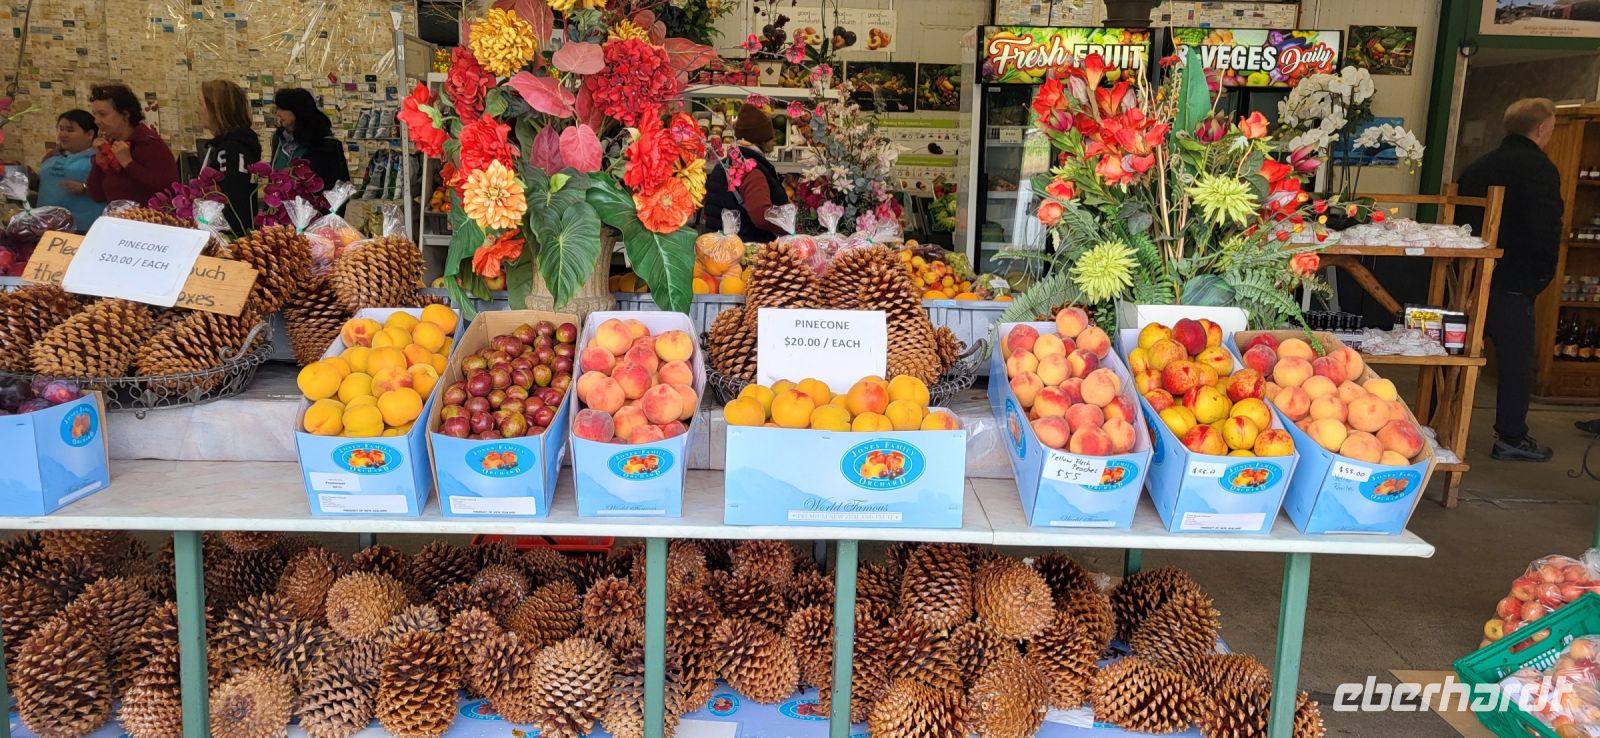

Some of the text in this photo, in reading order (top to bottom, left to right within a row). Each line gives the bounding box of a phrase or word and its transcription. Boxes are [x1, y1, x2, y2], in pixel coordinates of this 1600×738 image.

[990, 36, 1068, 75] Fresh
[1200, 45, 1277, 71] VEGES
[1281, 43, 1333, 75] Daily
[118, 239, 169, 254] PINECONE
[99, 252, 133, 265] $20.00
[141, 259, 170, 271] EACH
[795, 319, 850, 330] PINECONE
[784, 336, 861, 349] $20.00 / EACH
[884, 441, 916, 456] FAMILY
[858, 477, 906, 487] ORCHARD
[803, 496, 889, 512] World Famous
